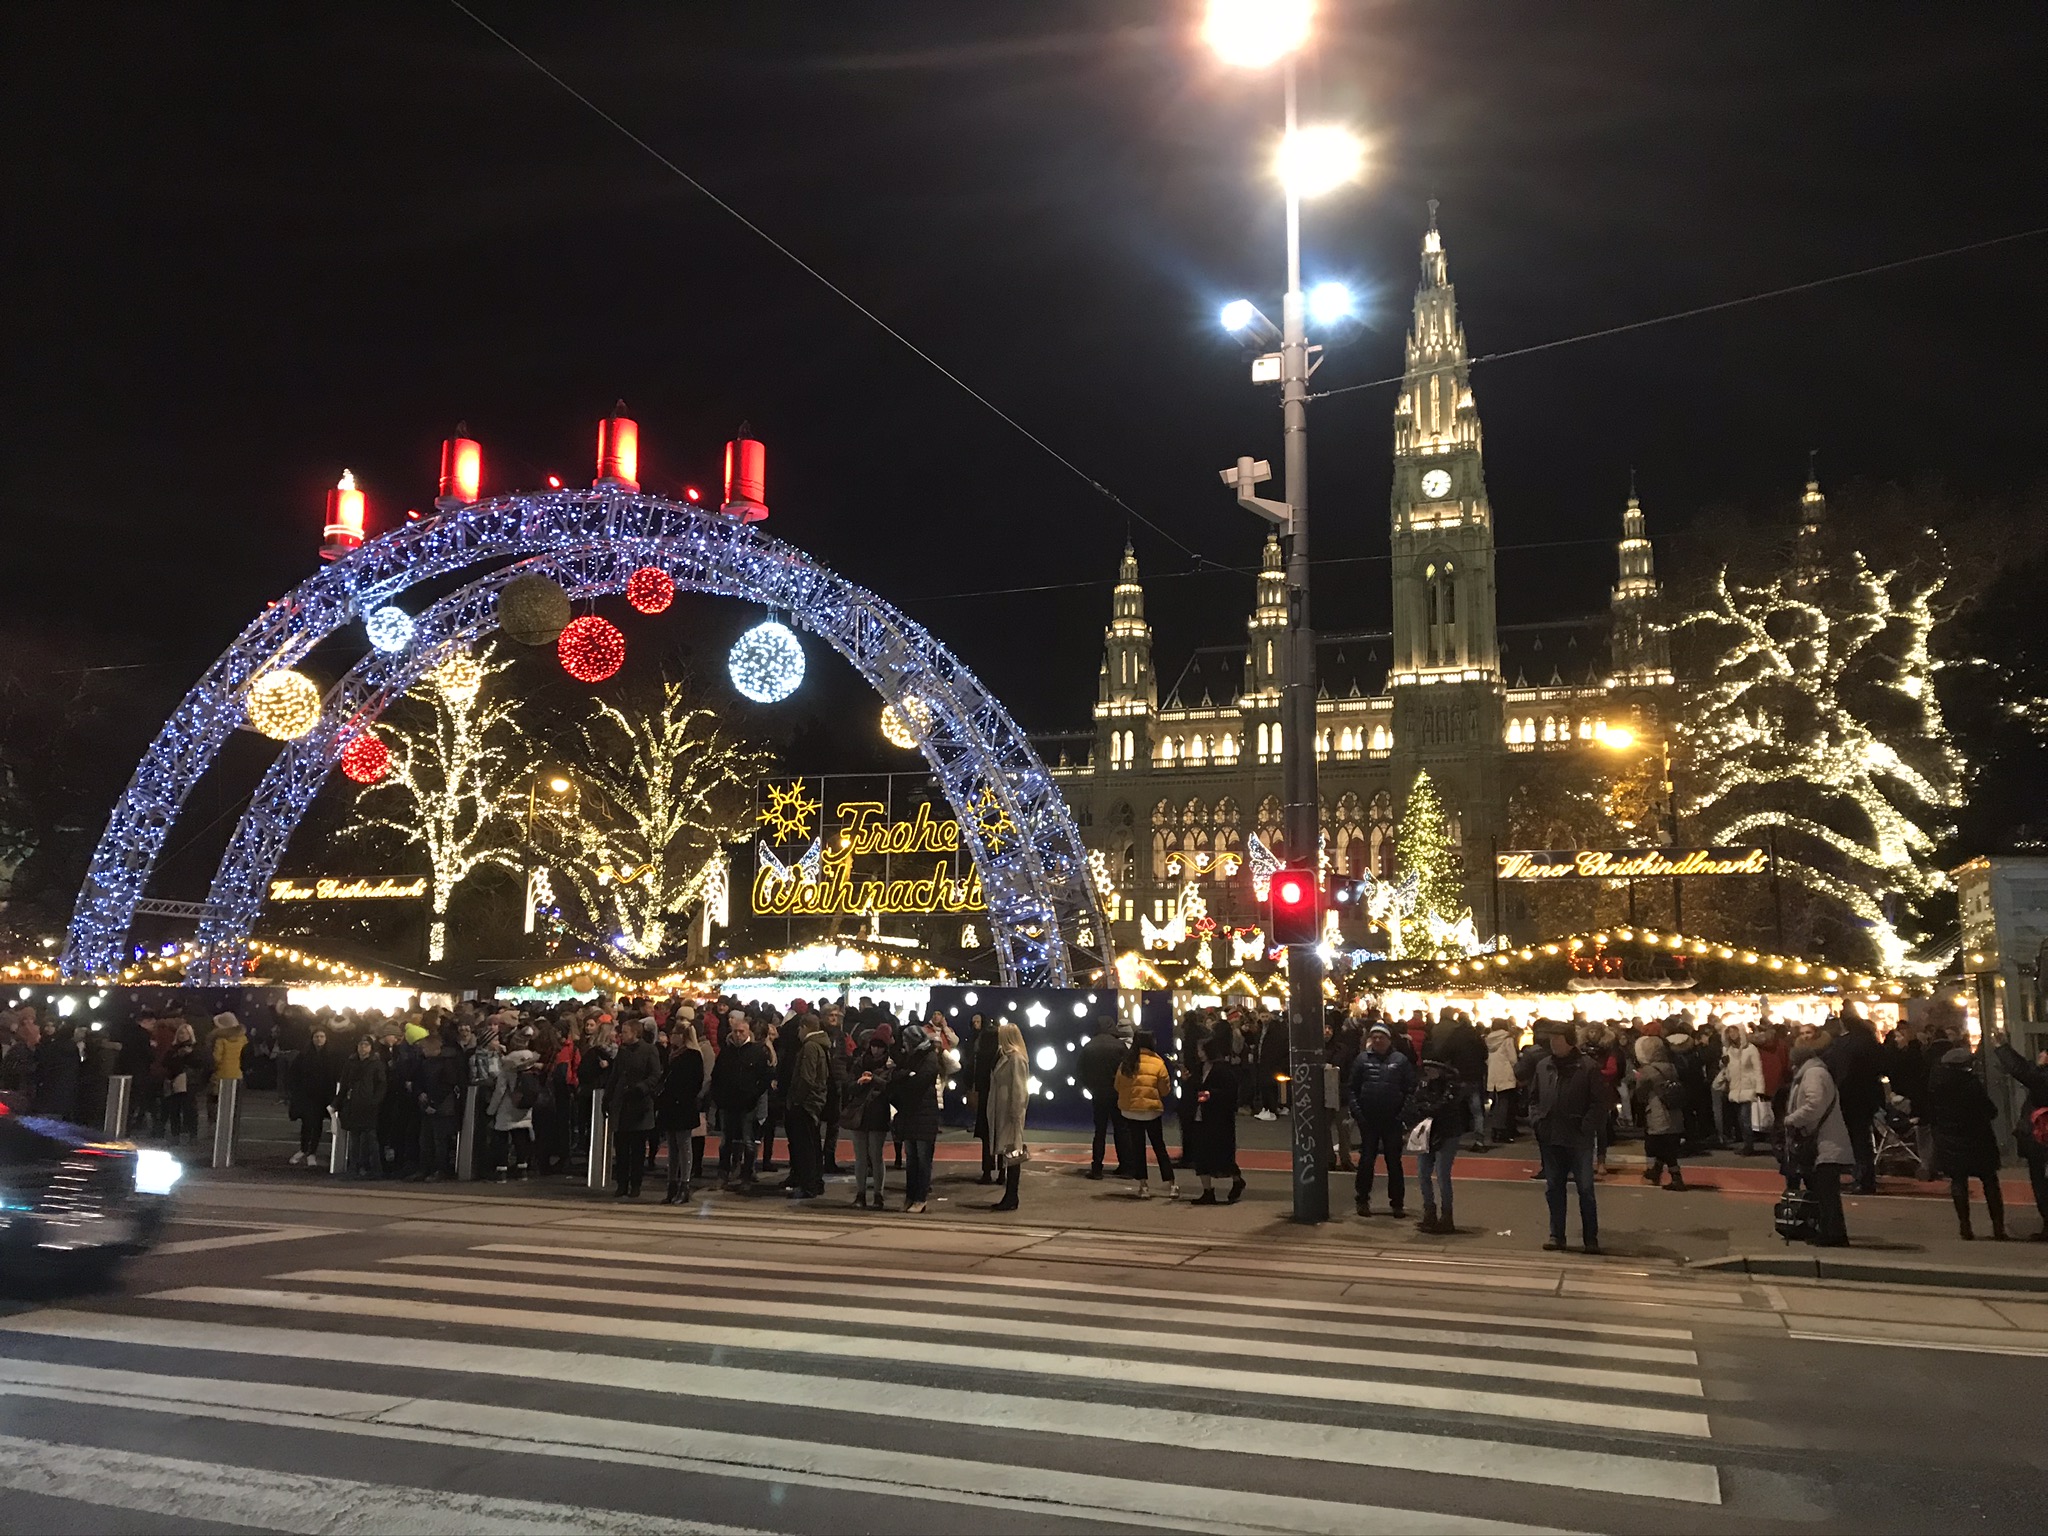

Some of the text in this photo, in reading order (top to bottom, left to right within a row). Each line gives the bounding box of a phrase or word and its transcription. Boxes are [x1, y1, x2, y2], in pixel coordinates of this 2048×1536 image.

[822, 802, 959, 864] Frohe
[753, 861, 989, 914] Weihnacht
[1497, 849, 1769, 878] Wiener Christkindlmarkt
